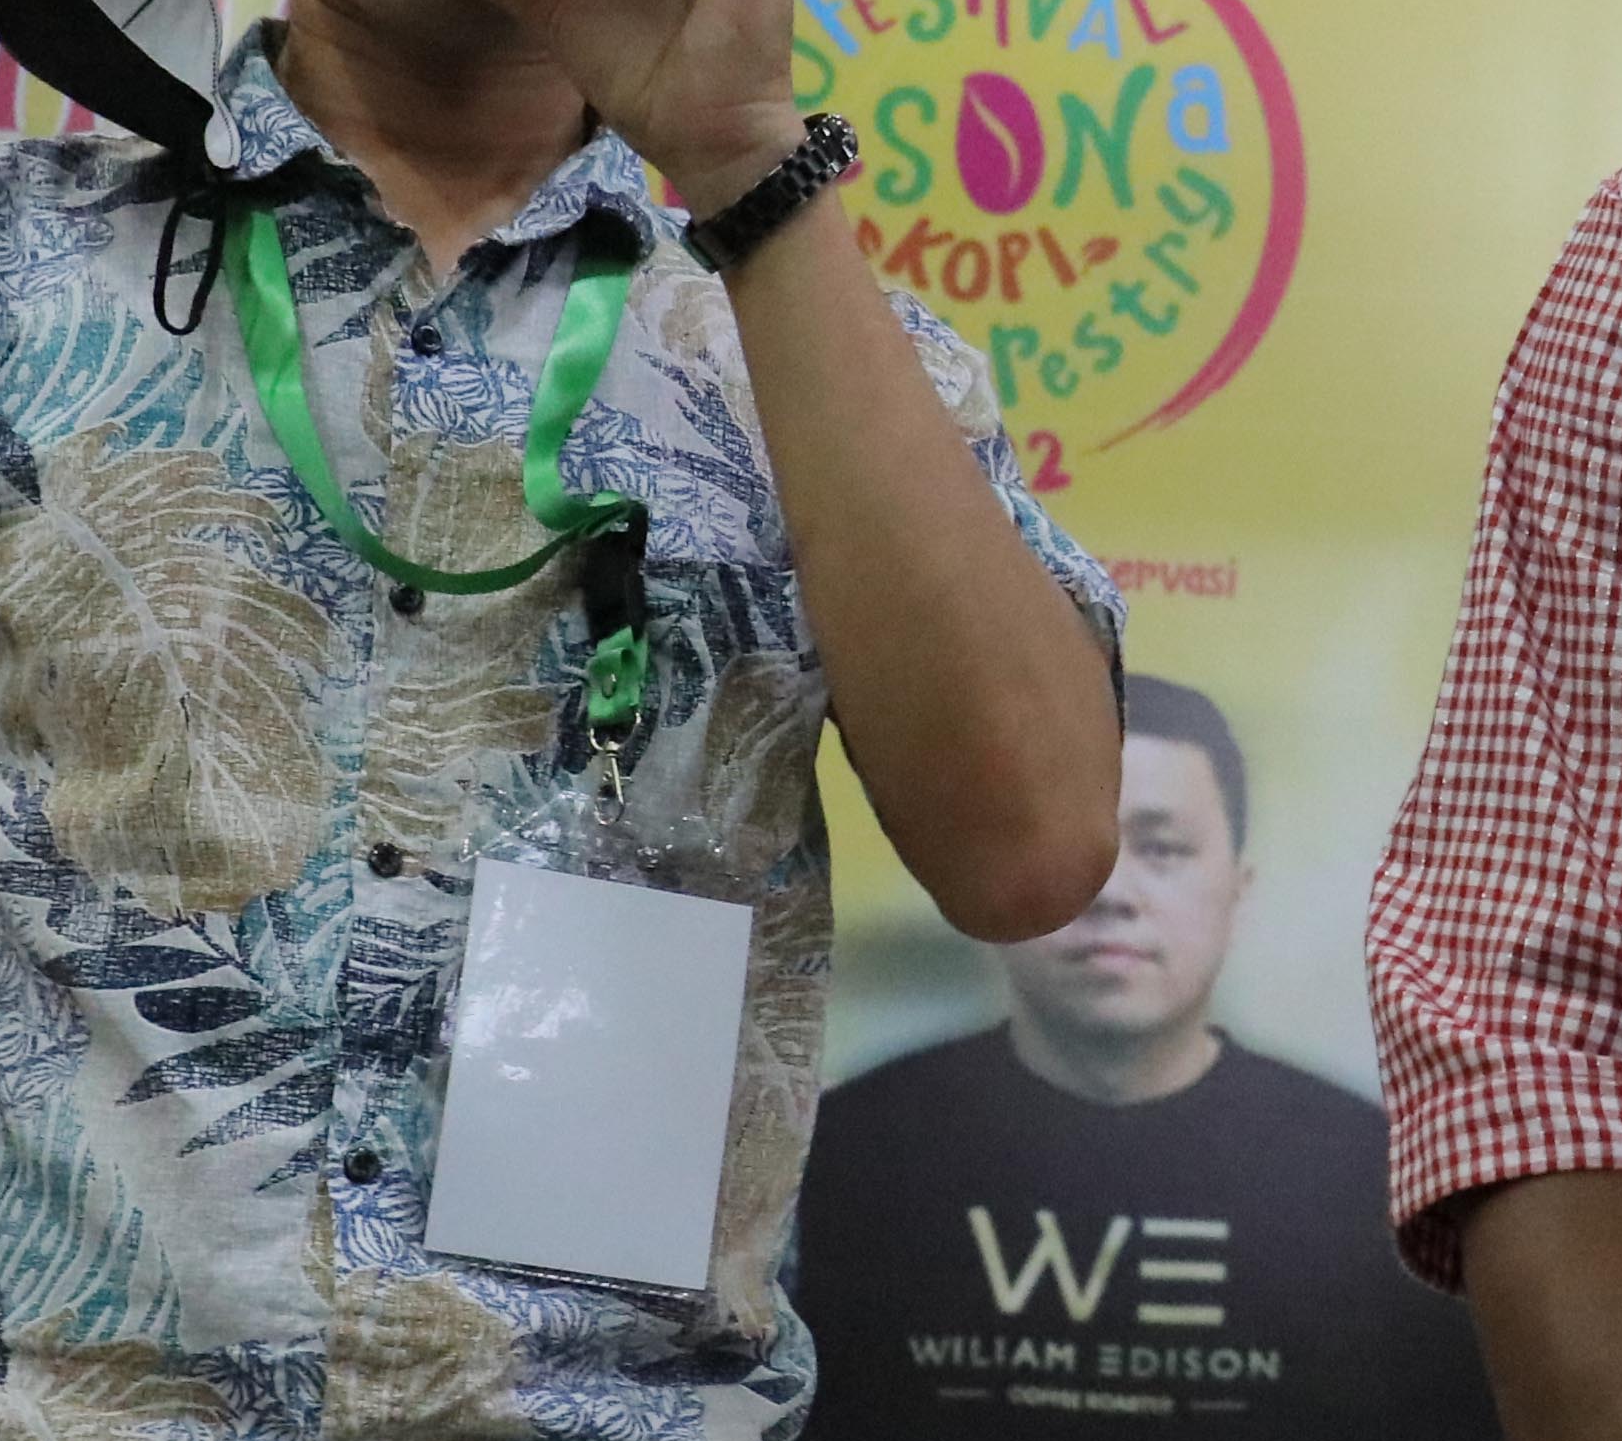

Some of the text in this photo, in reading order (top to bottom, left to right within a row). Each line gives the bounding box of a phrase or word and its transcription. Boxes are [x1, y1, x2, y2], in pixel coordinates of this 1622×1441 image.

[967, 1205, 1230, 1326] WE
[909, 1334, 1281, 1380] WILIAM EDISON
